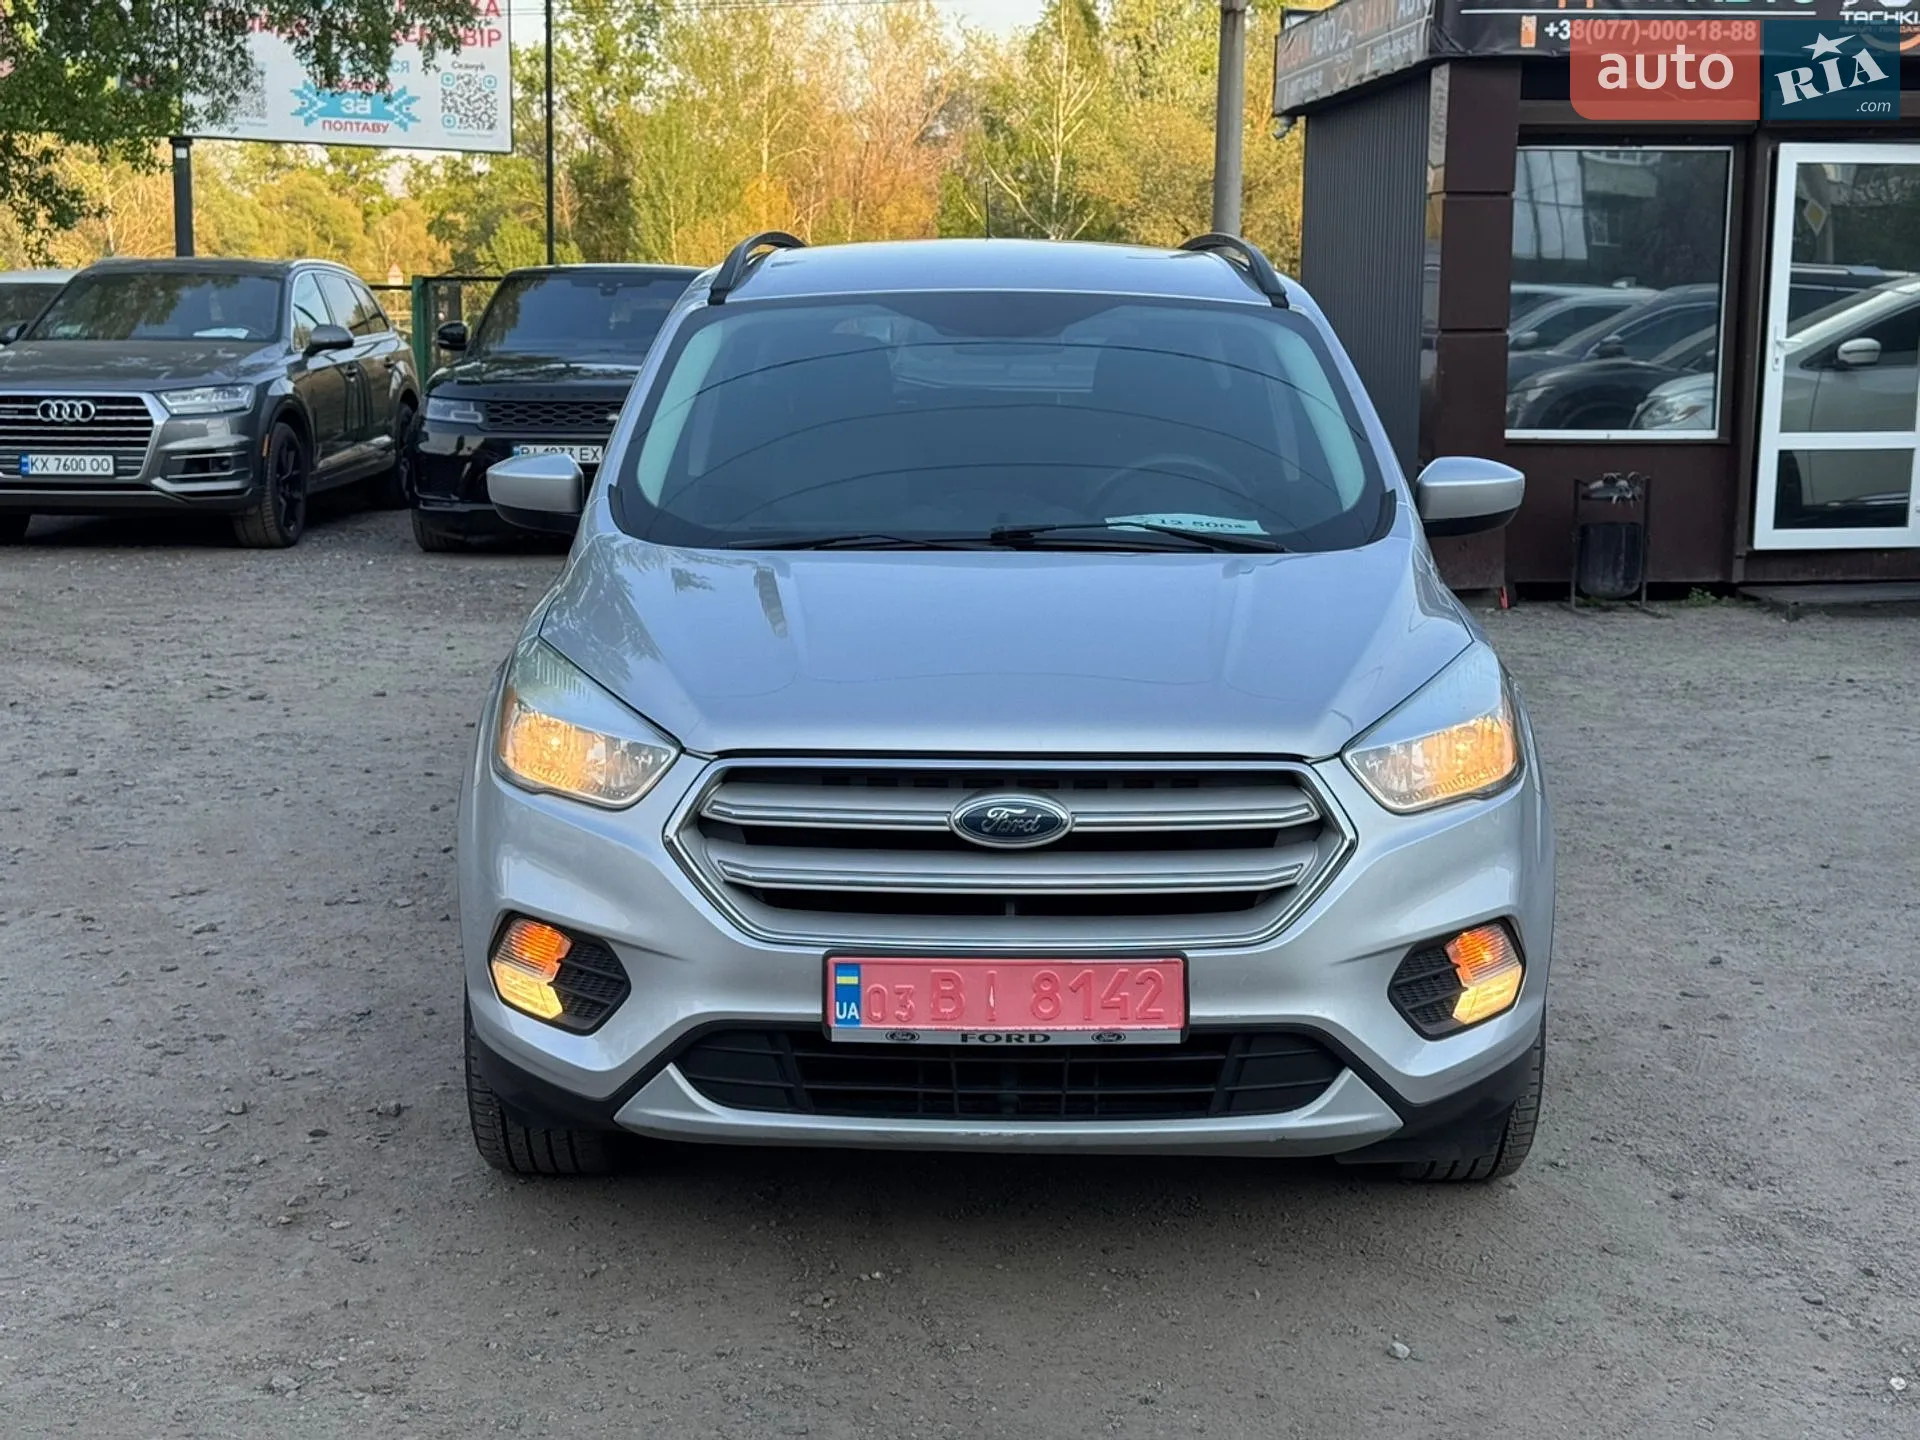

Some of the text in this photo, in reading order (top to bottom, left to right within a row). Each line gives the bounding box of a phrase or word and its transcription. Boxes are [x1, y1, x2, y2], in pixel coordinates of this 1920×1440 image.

[1544, 19, 1757, 45] +38(077)-000-18-88
[322, 119, 390, 134] ПОЛТАВУ
[30, 457, 50, 472] KX
[54, 457, 87, 472] 7600
[981, 806, 1042, 834] Ford
[866, 983, 915, 1023] 03
[1030, 968, 1165, 1022] 8142
[835, 1001, 860, 1020] UA
[960, 1032, 1051, 1045] FORD
